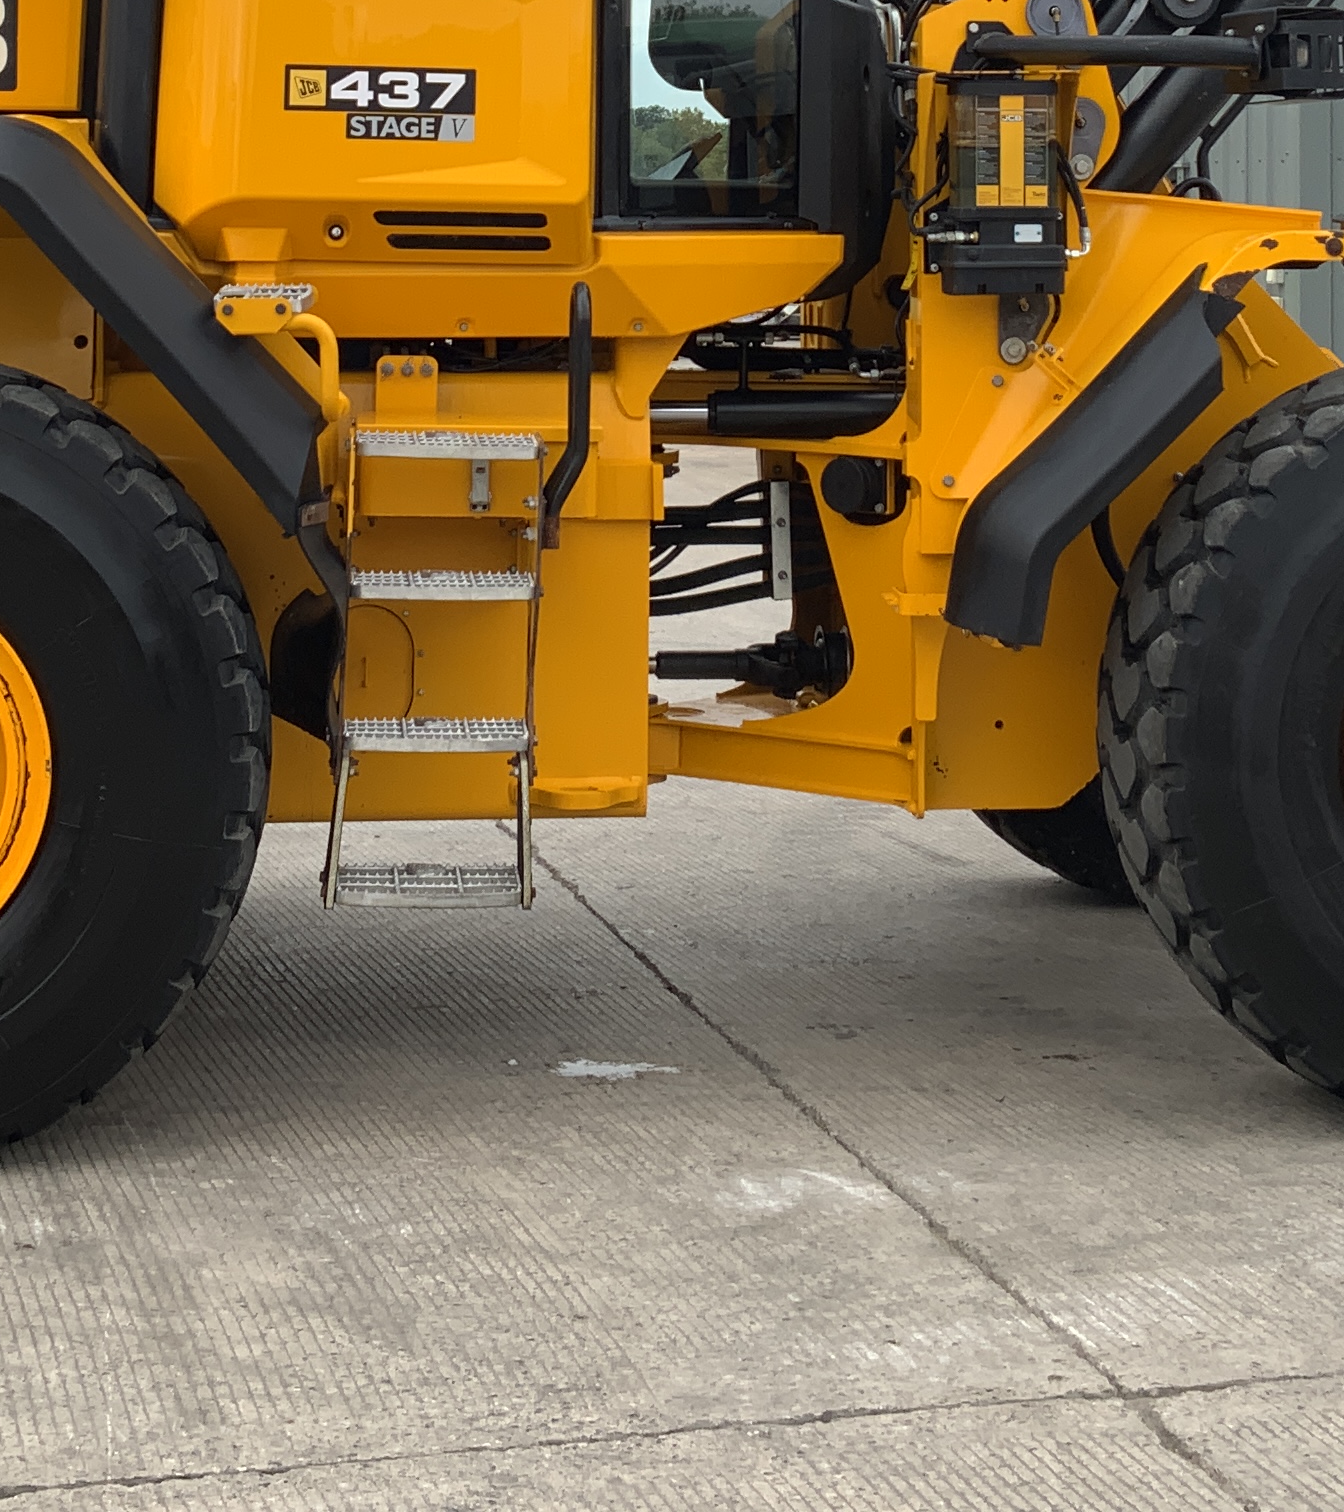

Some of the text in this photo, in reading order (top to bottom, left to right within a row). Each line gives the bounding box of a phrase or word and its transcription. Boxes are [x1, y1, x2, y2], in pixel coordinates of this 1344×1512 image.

[299, 71, 467, 110] JCB 437
[350, 116, 468, 139] STAGE V
